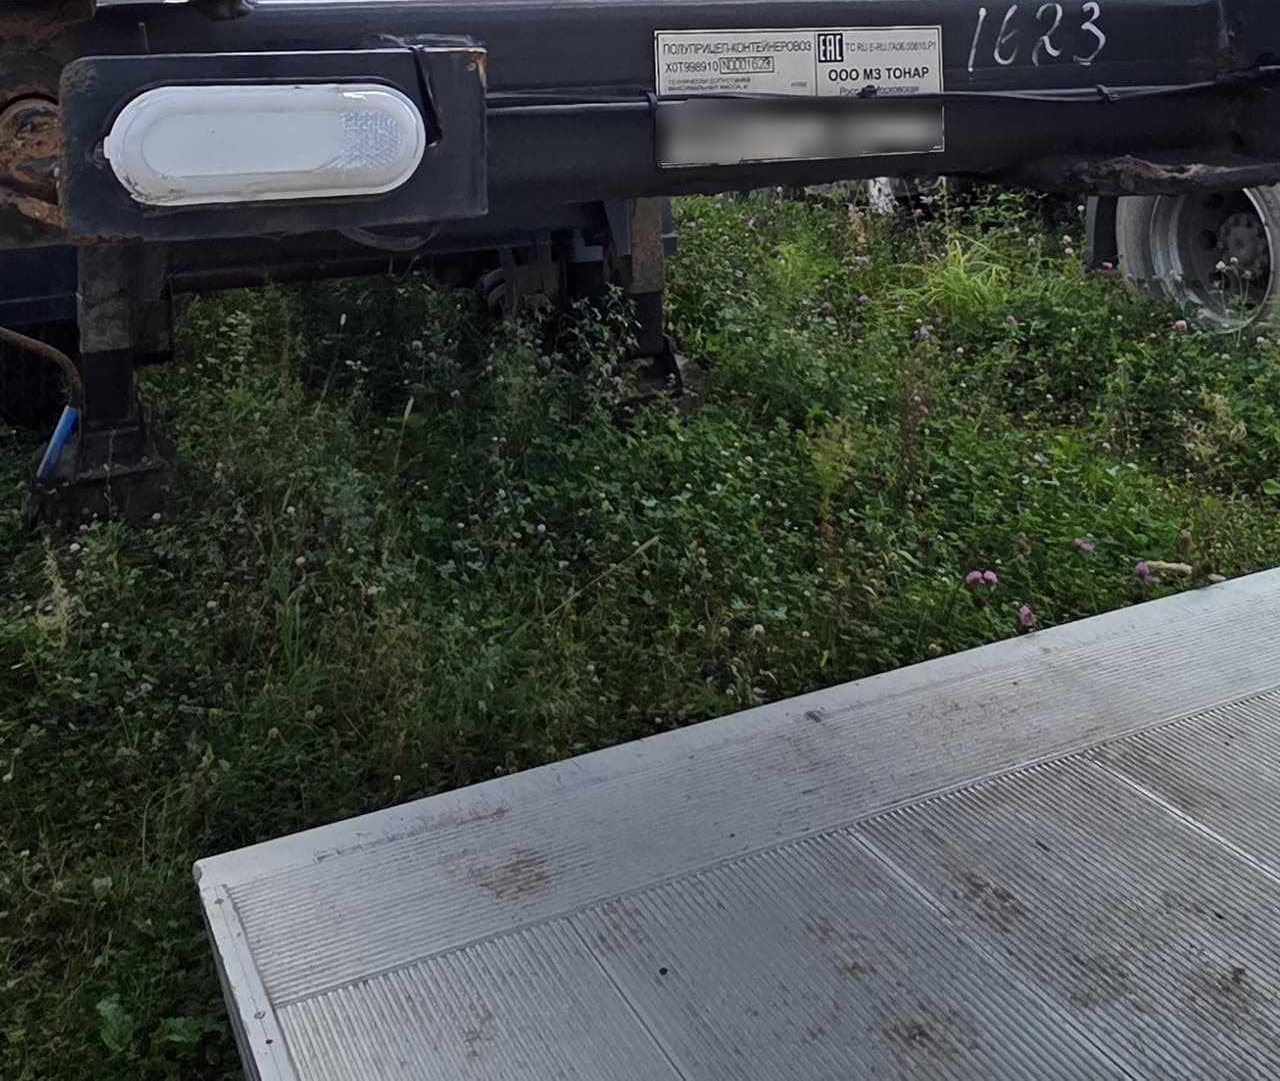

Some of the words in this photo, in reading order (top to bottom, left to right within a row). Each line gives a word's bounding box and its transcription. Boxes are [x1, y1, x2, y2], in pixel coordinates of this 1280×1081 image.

[967, 2, 1106, 72] 1623
[662, 40, 812, 56] ПОЛУПРИЦЕП-КОНТЕЙНЕРОВОЗ
[828, 69, 859, 81] ООО
[863, 68, 882, 80] МЗ
[886, 67, 929, 79] ТОНАР
